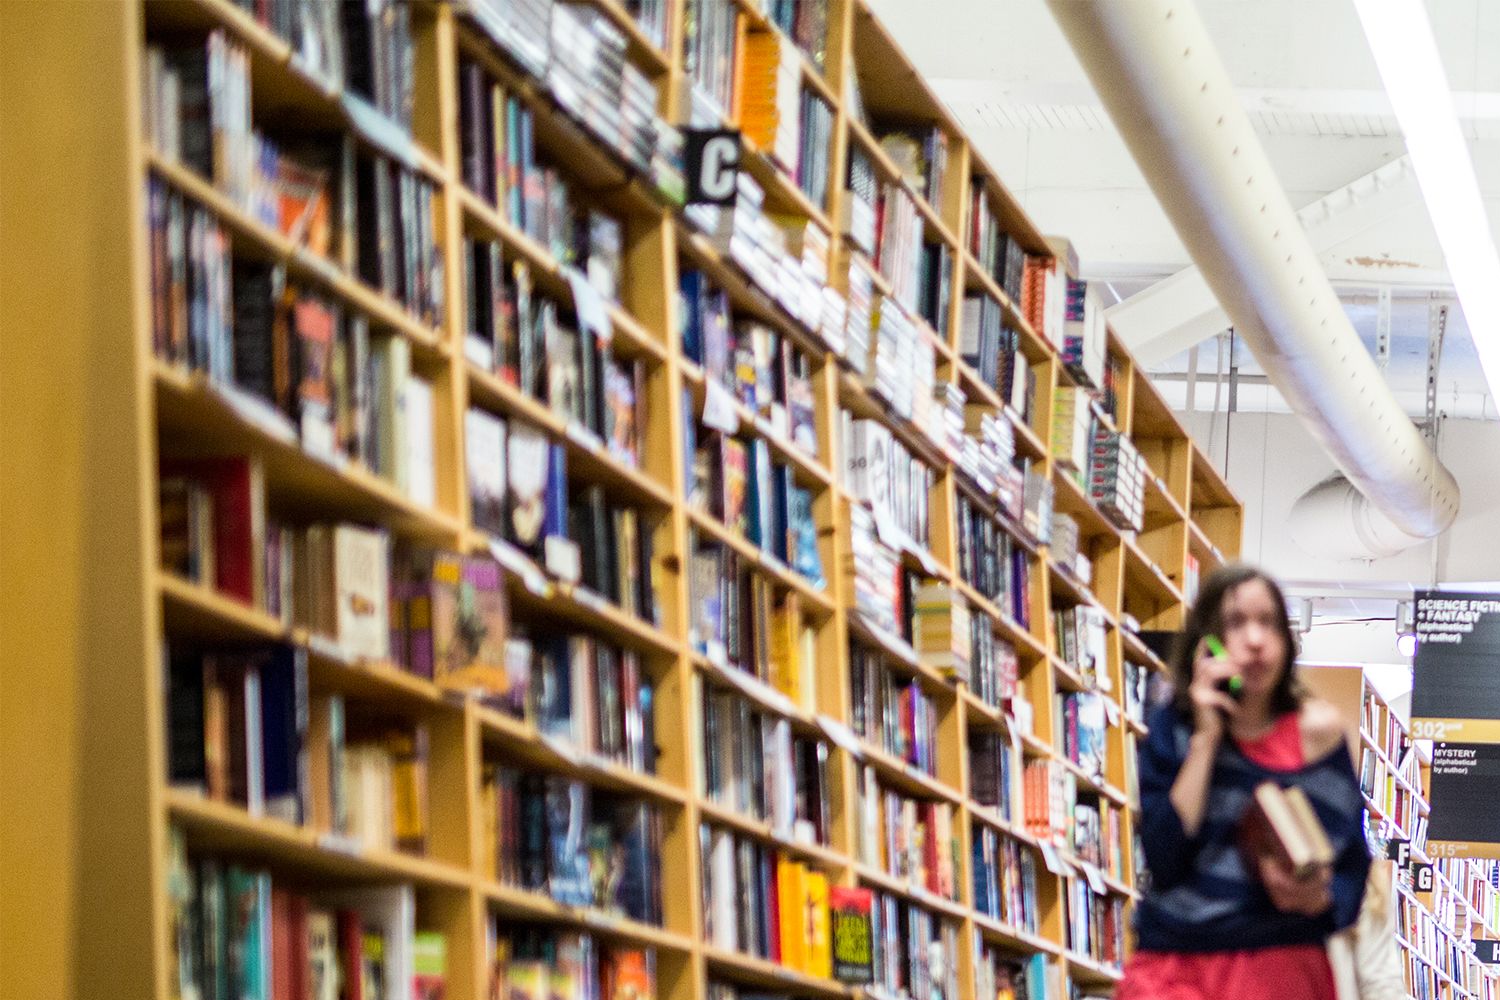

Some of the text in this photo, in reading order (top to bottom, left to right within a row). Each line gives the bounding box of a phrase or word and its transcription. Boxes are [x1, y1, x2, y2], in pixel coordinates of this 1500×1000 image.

[700, 136, 738, 200] C
[1417, 599, 1468, 611] SCIENCE
[1427, 611, 1481, 623] FANTASY
[1413, 721, 1445, 738] 302
[1434, 749, 1476, 758] MYSTERY
[1434, 758, 1477, 767] (alphabetical
[1433, 766, 1468, 775] by author)
[1398, 843, 1409, 867] F
[1430, 843, 1456, 856] 315
[1418, 868, 1432, 890] G
